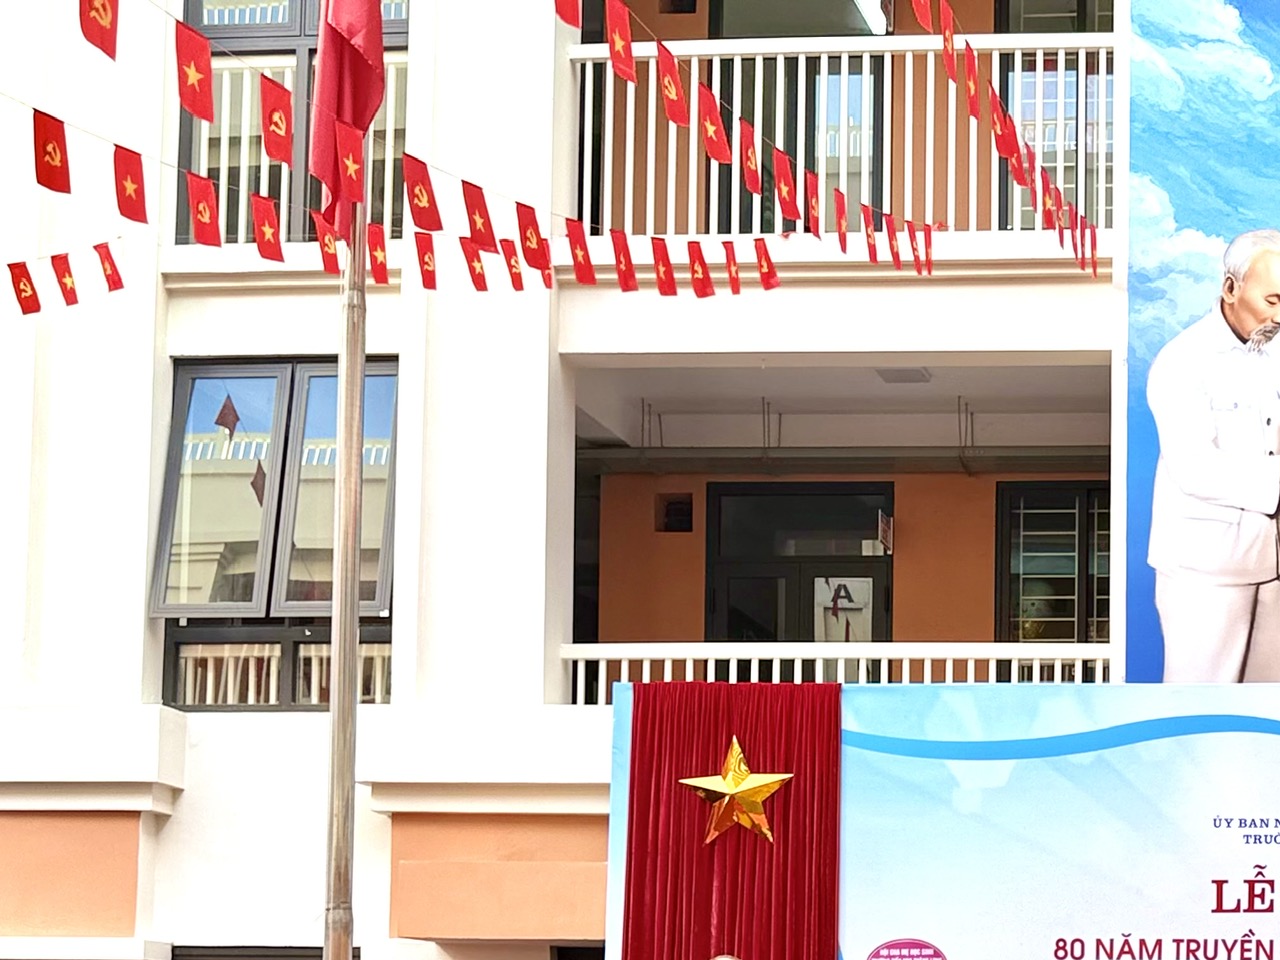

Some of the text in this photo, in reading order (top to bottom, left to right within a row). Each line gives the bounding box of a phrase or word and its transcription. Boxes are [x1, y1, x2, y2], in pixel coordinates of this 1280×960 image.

[1213, 815, 1234, 828] ỦY
[1238, 818, 1270, 828] BAN
[1211, 864, 1275, 914] LỄ
[1054, 938, 1085, 960] 80
[1095, 932, 1162, 960] NĂM
[1172, 929, 1274, 960] TRUYỀN
